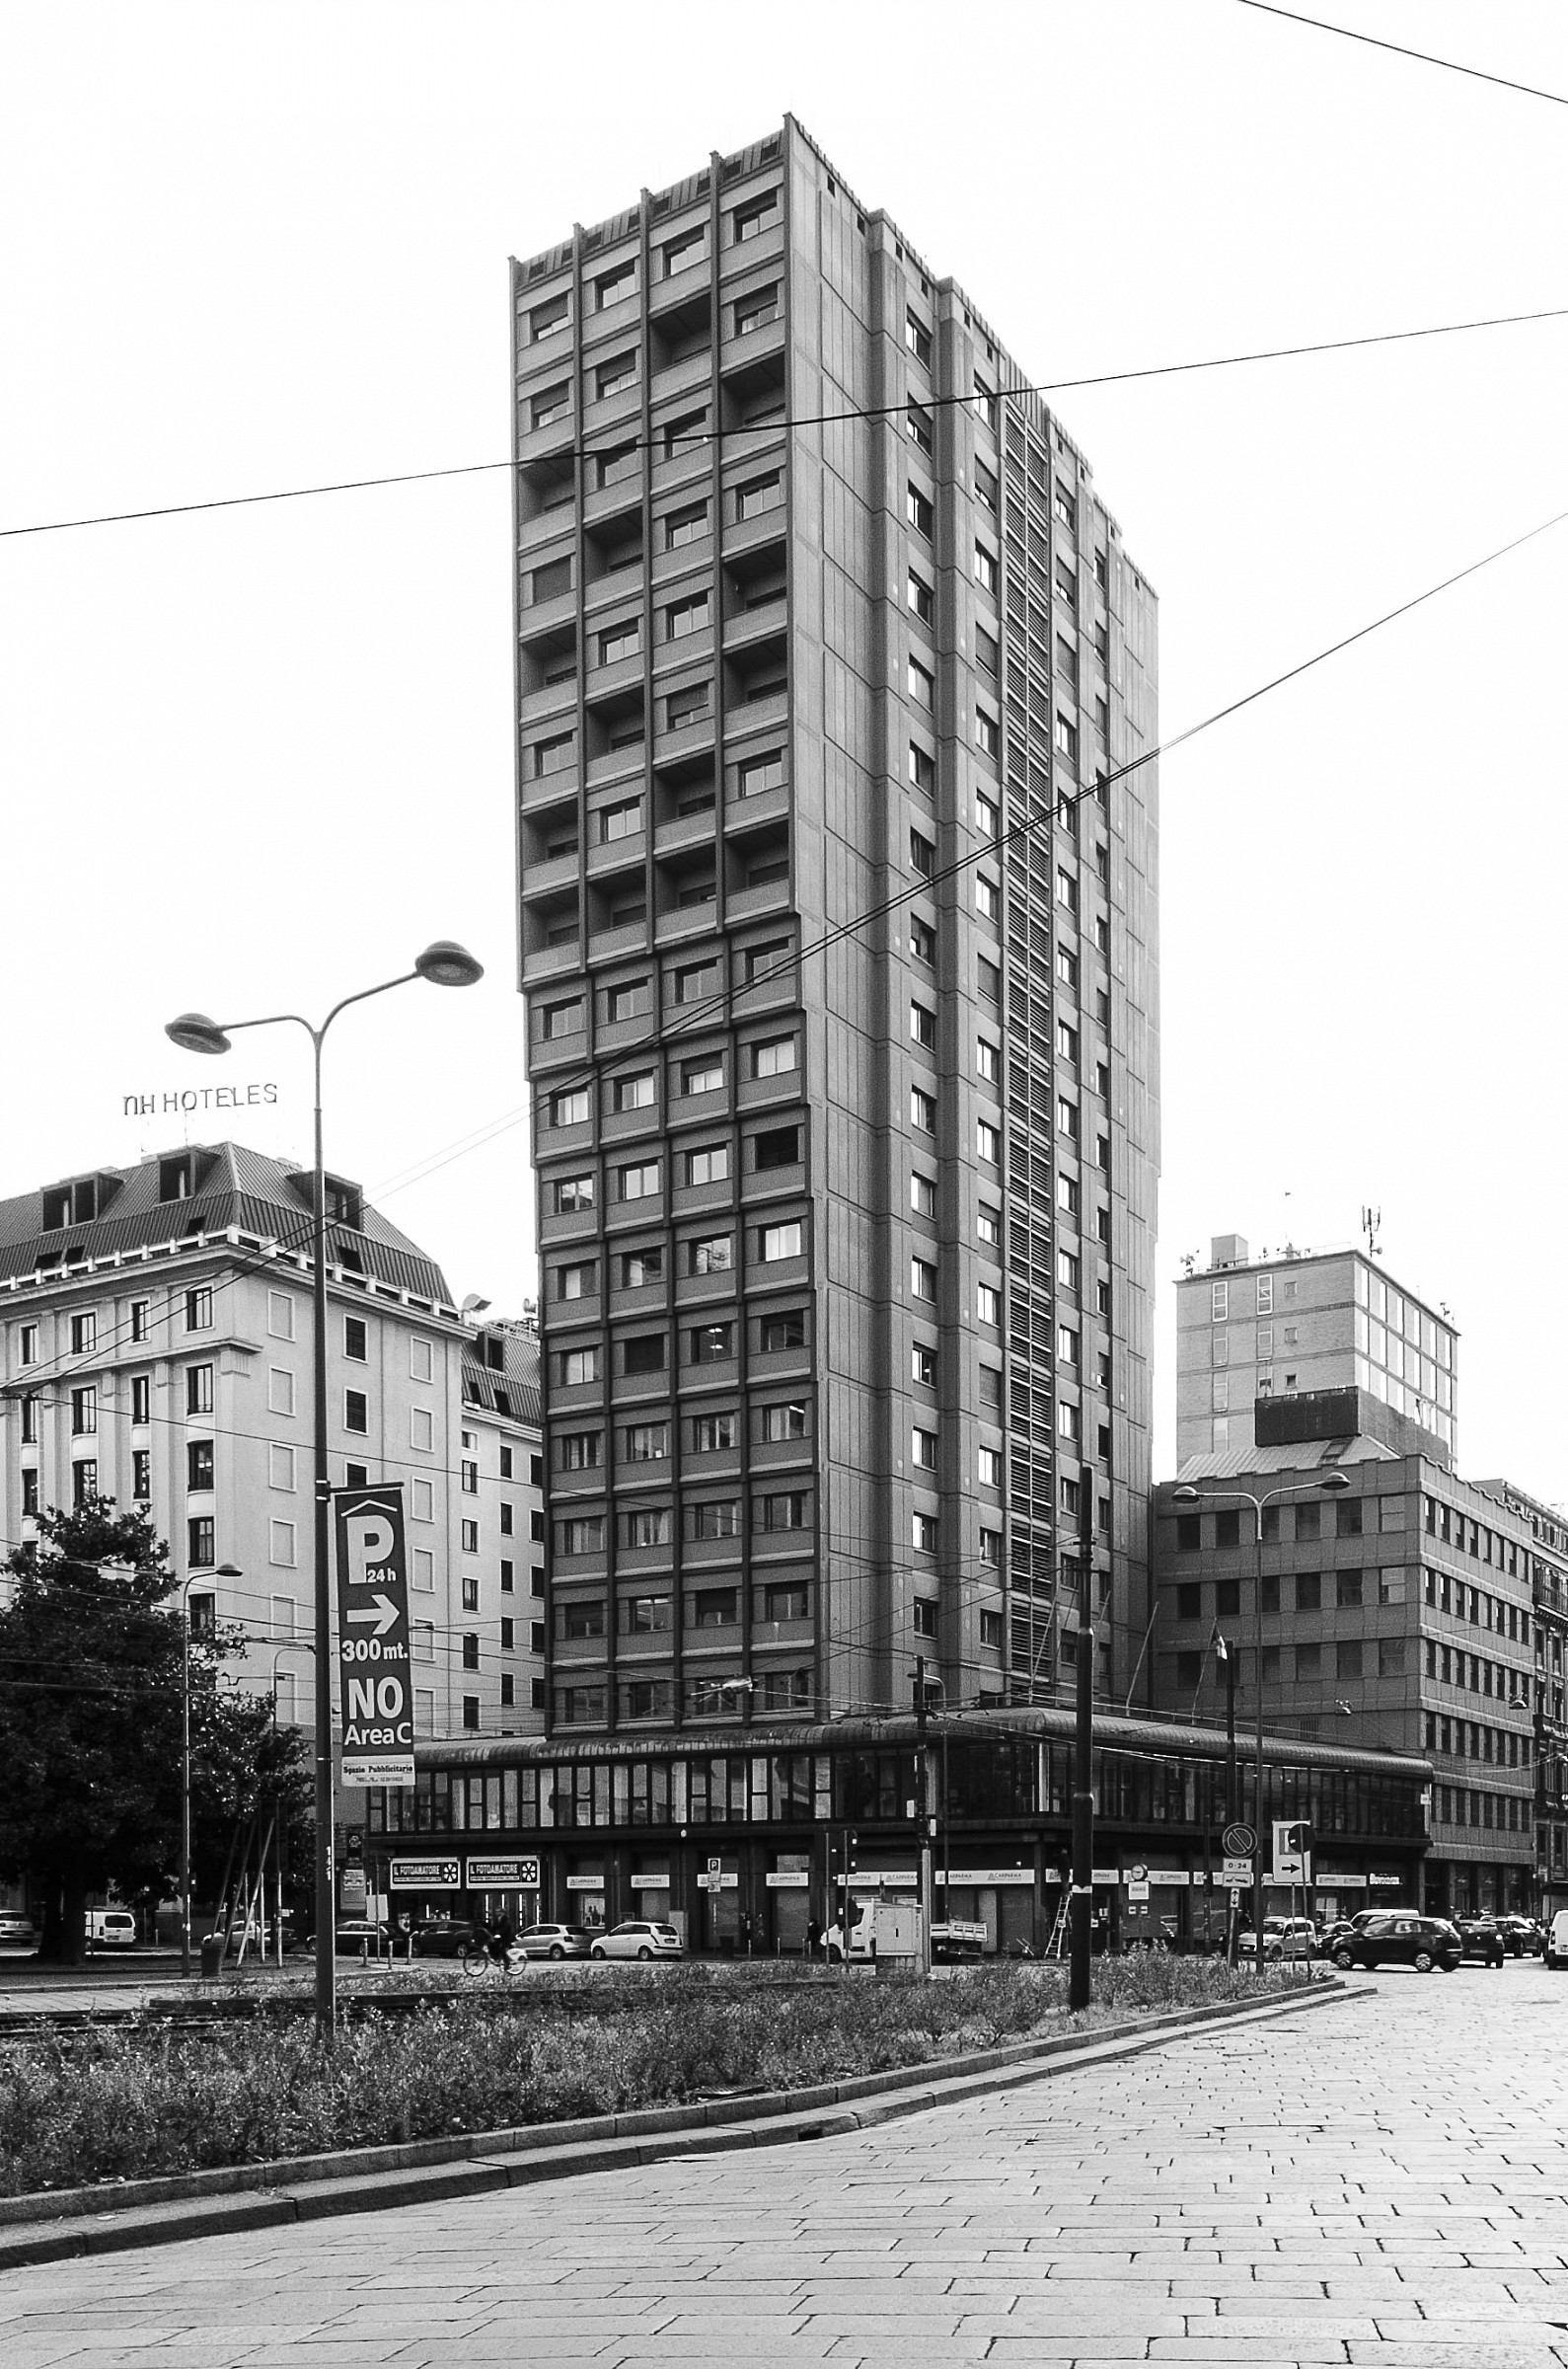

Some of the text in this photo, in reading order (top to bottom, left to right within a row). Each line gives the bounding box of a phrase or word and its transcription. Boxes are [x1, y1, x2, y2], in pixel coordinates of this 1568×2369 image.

[163, 1083, 277, 1112] HOTELES
[346, 1514, 395, 1584] P
[341, 1639, 409, 1662] 300 mt.
[348, 1676, 404, 1719] NO
[343, 1721, 411, 1746] Area C
[342, 1764, 413, 1775] Spazio Pubblicitario
[710, 1861, 717, 1870] P
